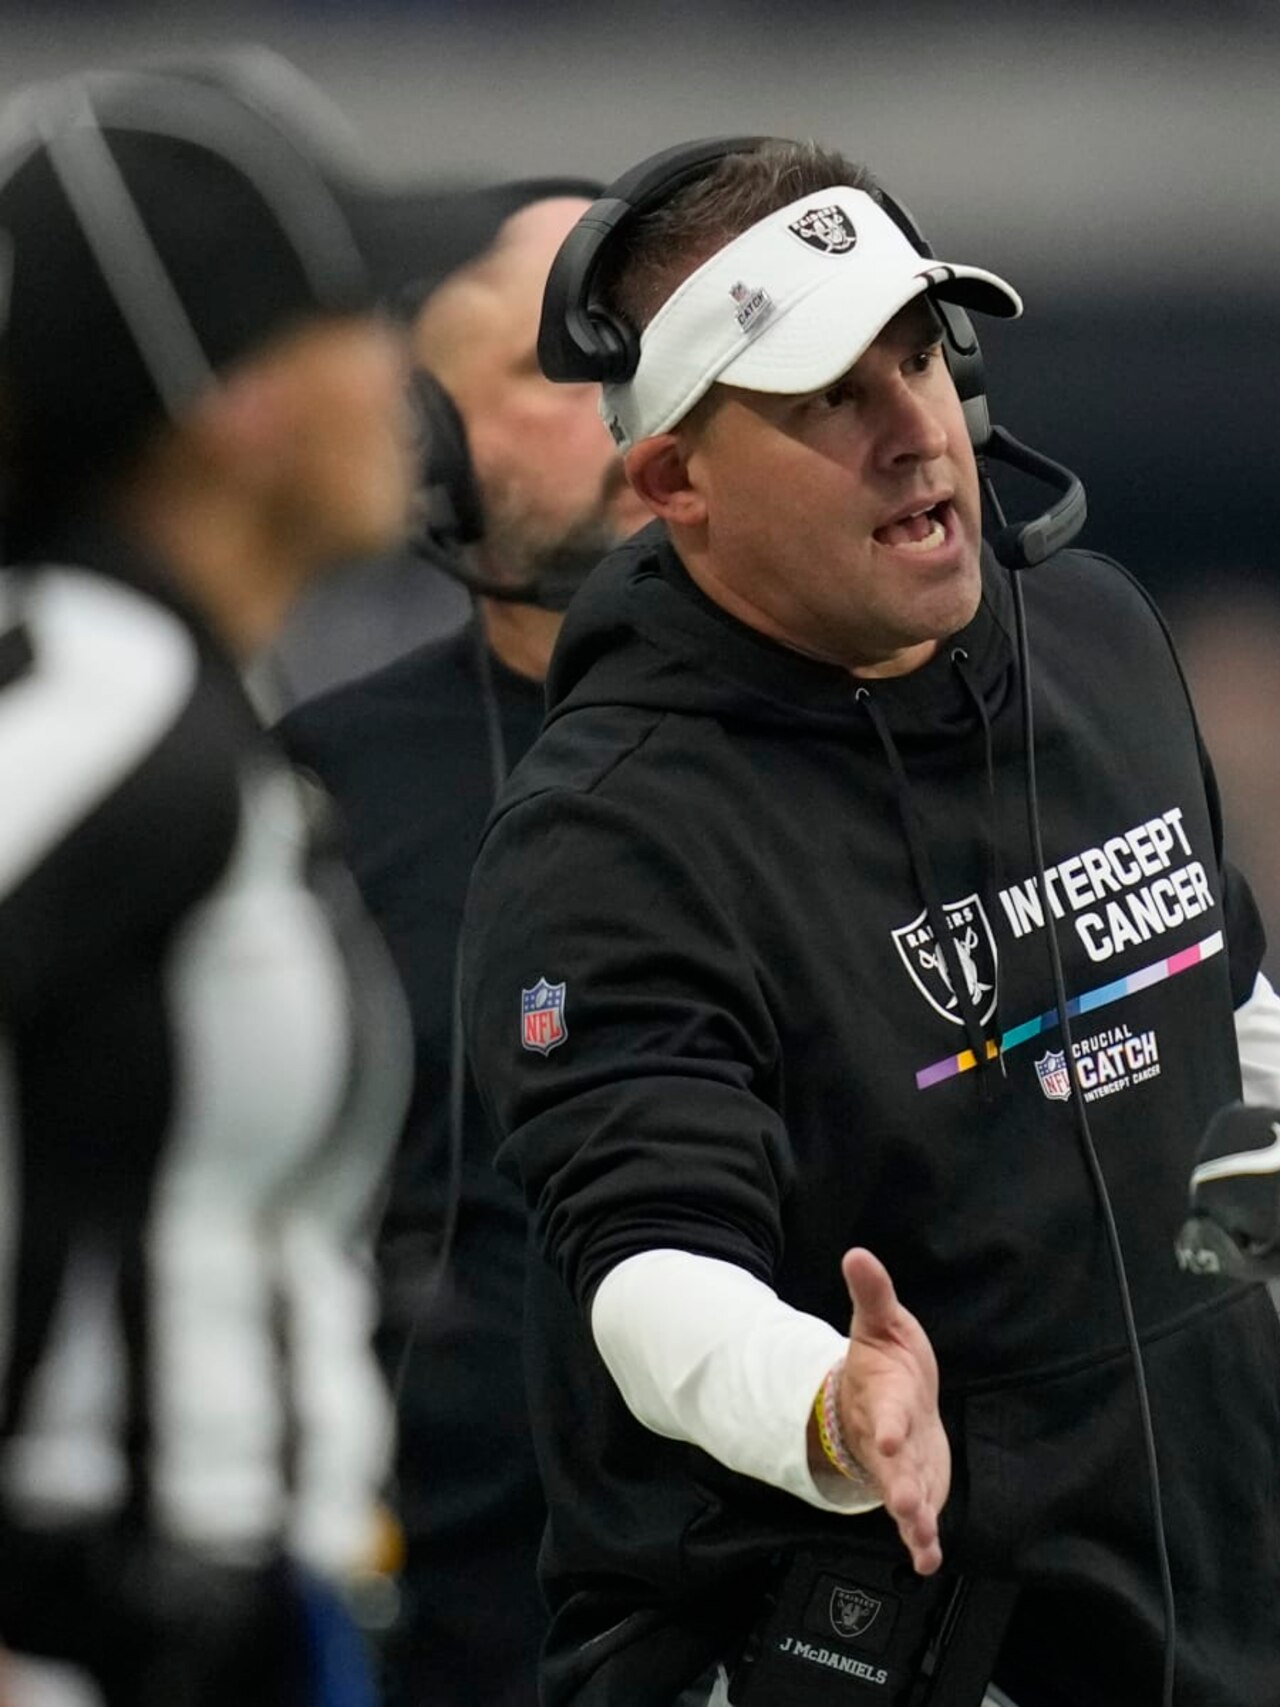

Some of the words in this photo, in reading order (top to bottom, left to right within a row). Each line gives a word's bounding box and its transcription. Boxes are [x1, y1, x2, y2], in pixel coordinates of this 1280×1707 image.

[998, 806, 1193, 938] INTERCEPT
[1074, 861, 1216, 963] CANCER
[526, 1010, 561, 1044] NFL
[1071, 1024, 1133, 1059] CRUCIAL
[1076, 1030, 1159, 1090] CATCH
[1083, 1076, 1130, 1103] INTERCEPT
[1132, 1063, 1161, 1085] CANCER
[780, 1637, 794, 1651] J
[792, 1640, 889, 1685] McDANIELS
